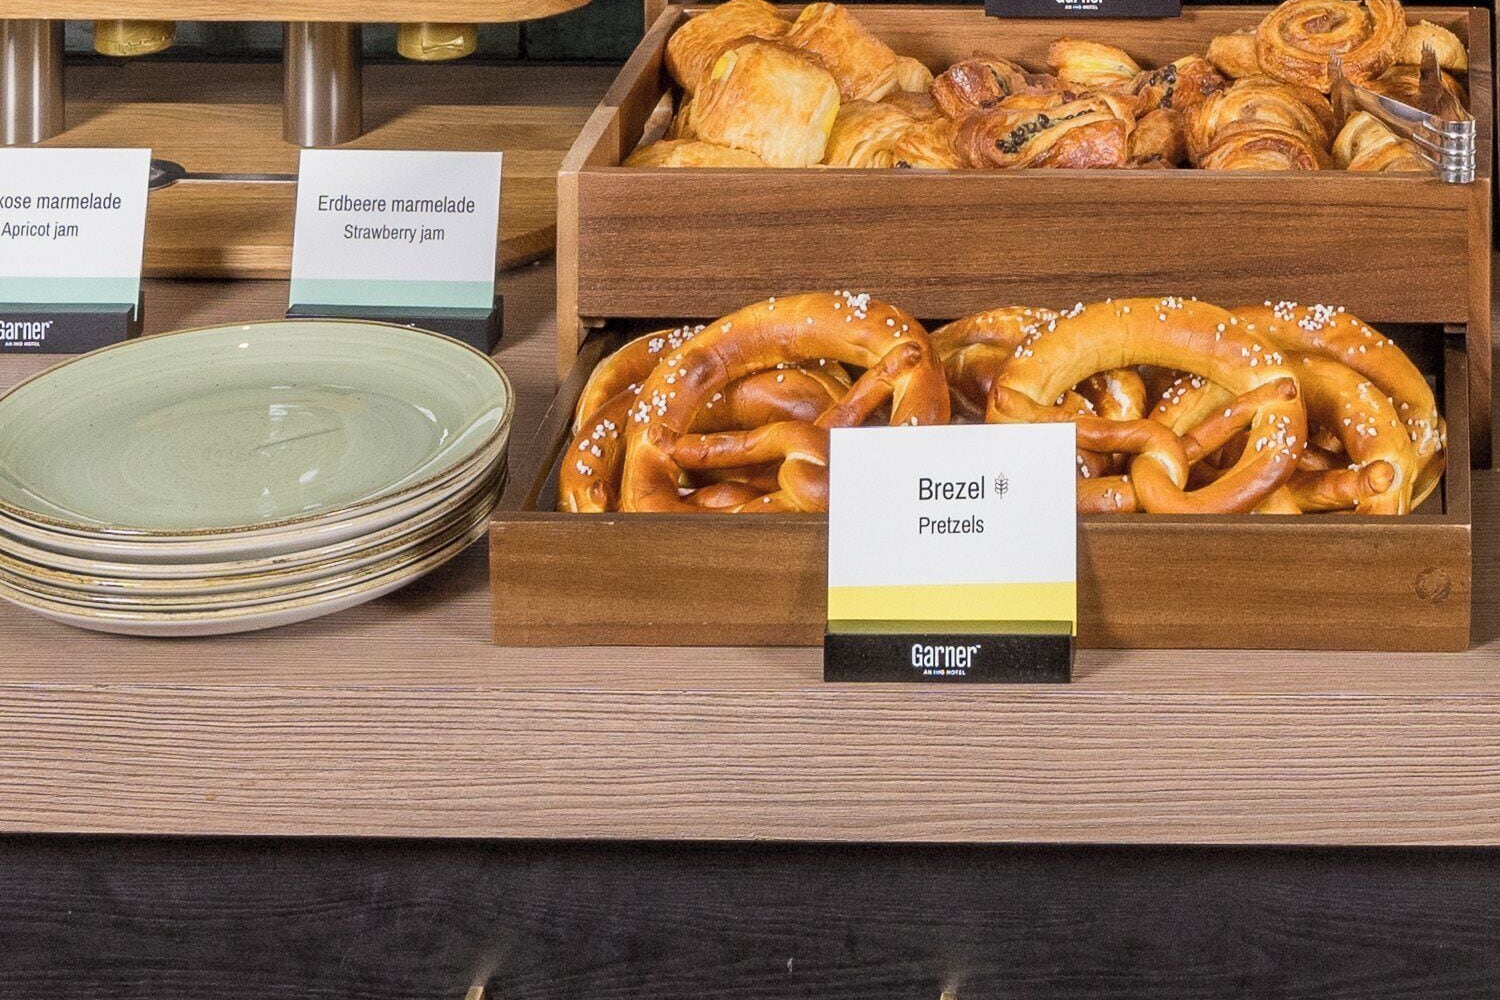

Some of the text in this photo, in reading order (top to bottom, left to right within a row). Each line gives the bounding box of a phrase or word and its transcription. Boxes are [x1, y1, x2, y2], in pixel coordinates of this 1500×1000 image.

[36, 192, 122, 210] marmelade
[318, 194, 475, 214] Erdbeere marmelade
[0, 220, 79, 241] Apricot jam
[343, 223, 445, 244] Strawberry jam
[918, 475, 985, 501] Brezel
[918, 514, 985, 535] Pretzels
[912, 644, 978, 667] Garner
